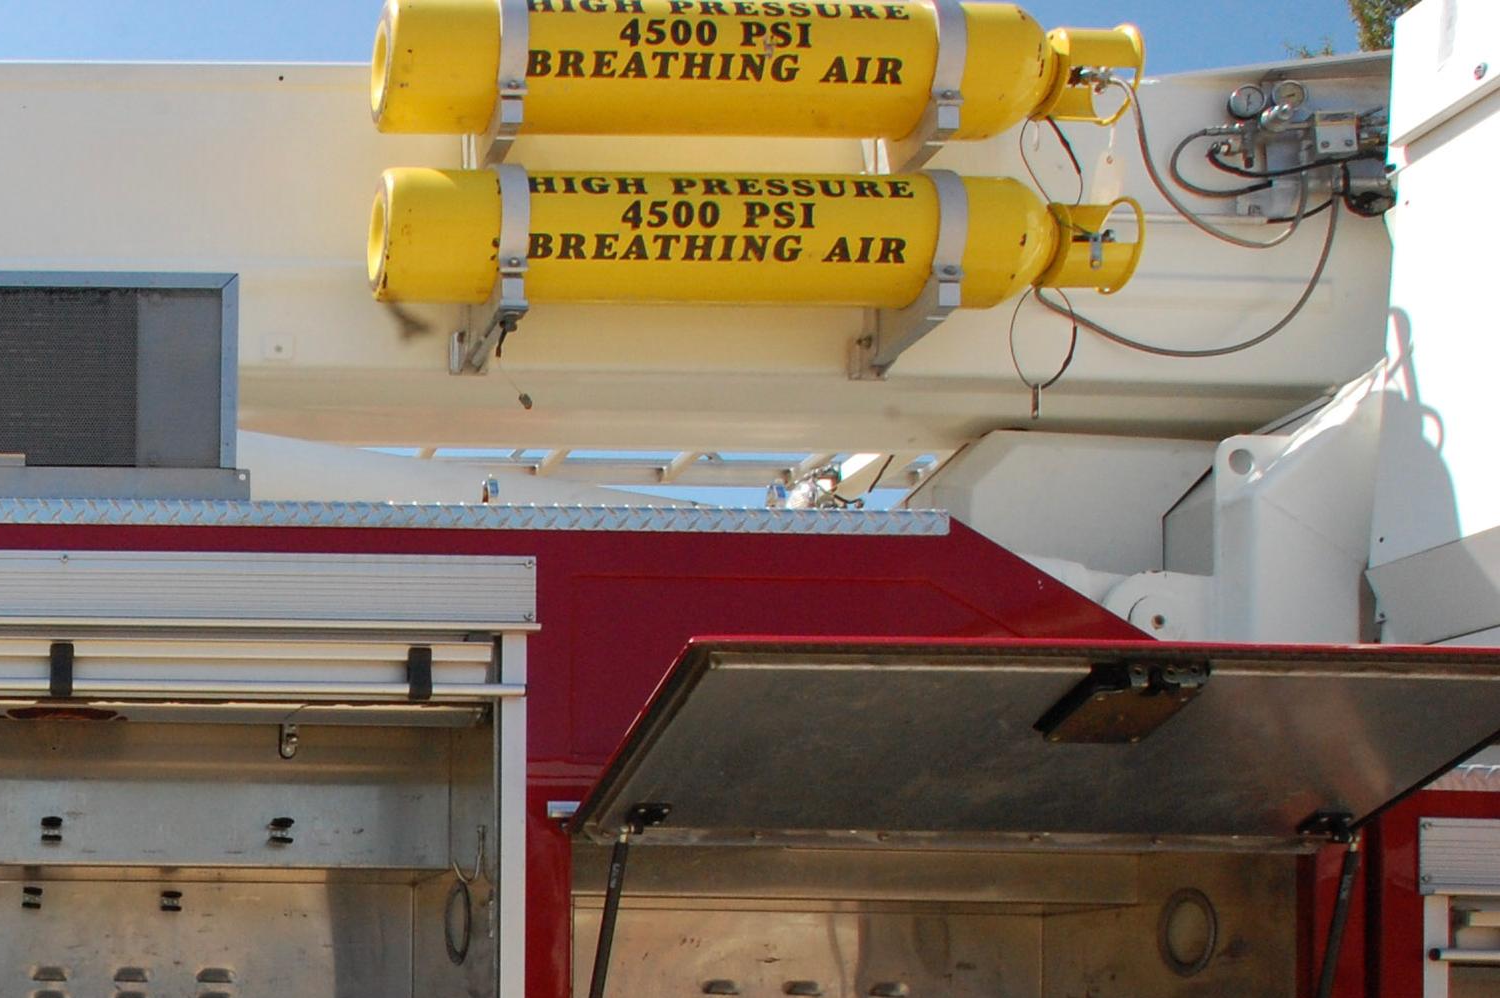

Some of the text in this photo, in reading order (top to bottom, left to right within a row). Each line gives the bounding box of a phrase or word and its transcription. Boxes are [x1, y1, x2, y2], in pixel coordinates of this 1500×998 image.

[528, 0, 910, 20] HIGH PRESSURE
[619, 18, 813, 49] 4500 PSI
[526, 49, 904, 86] BREATHING AIR
[528, 176, 915, 199] HIGH PRESSURE
[620, 200, 817, 229] 4500 PSI
[526, 232, 908, 264] BREATHING AIR
